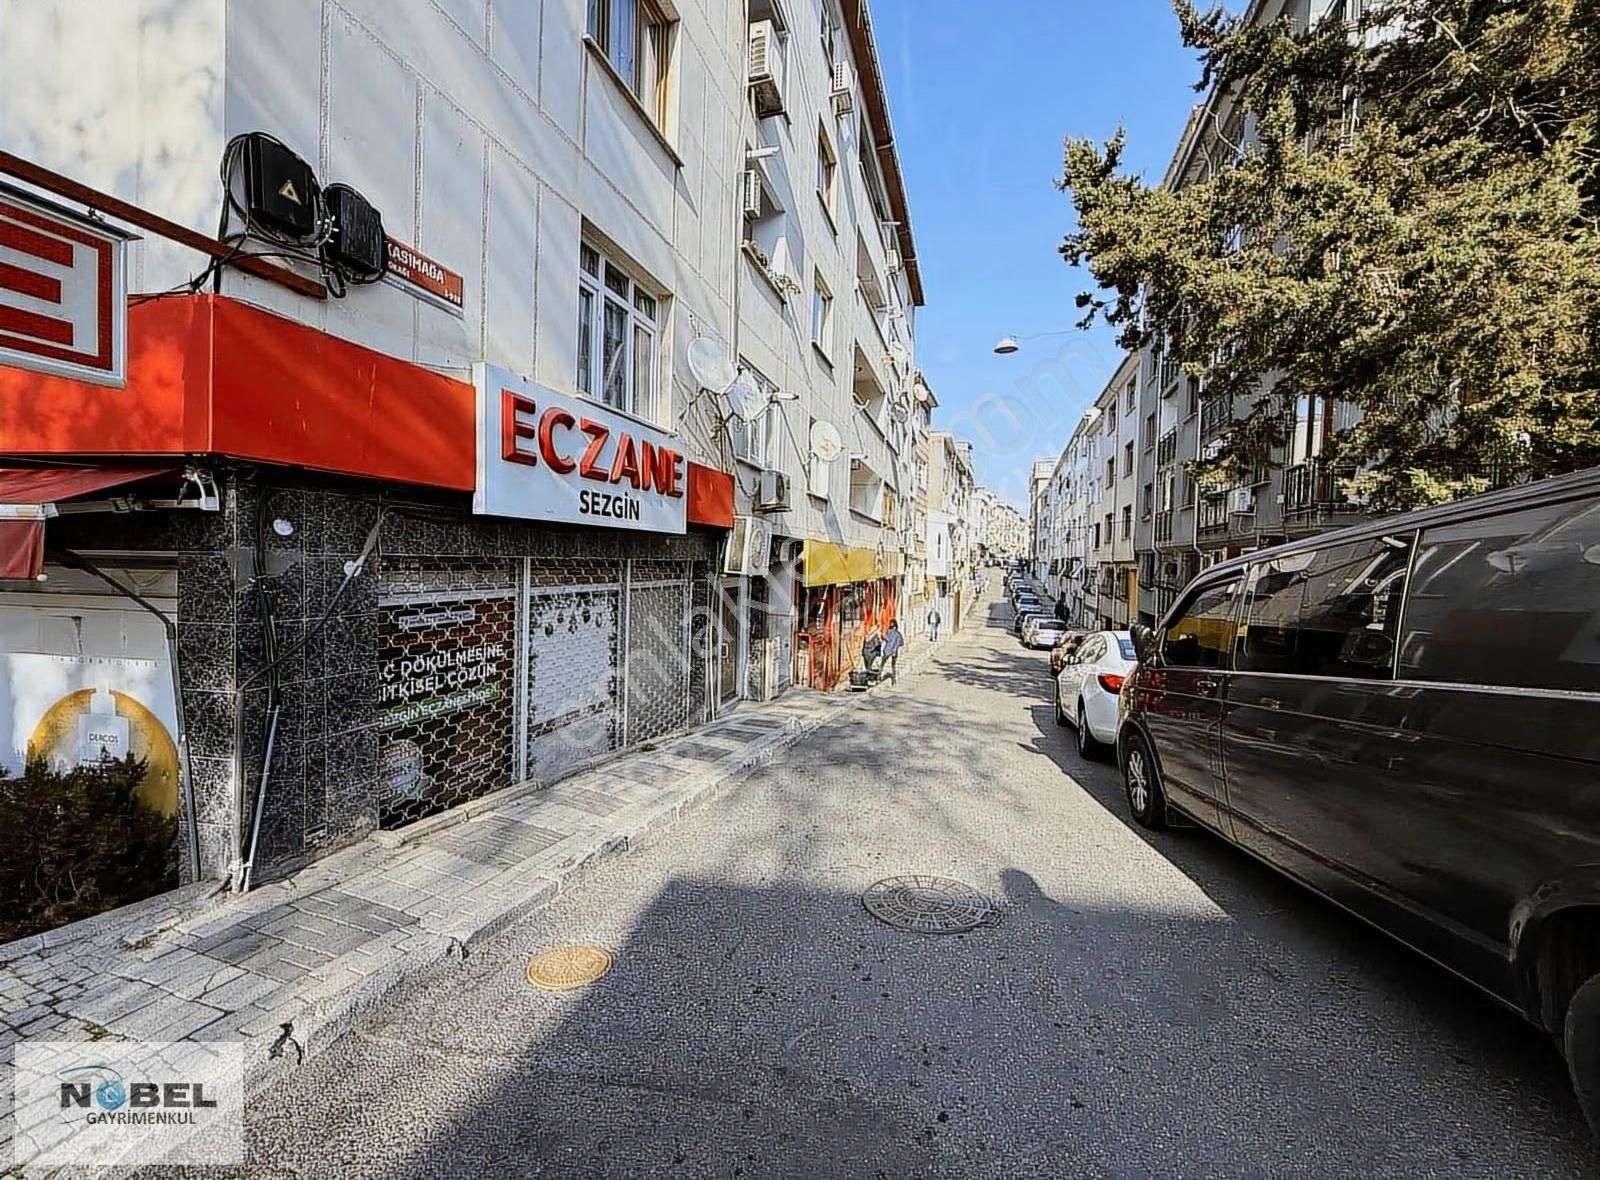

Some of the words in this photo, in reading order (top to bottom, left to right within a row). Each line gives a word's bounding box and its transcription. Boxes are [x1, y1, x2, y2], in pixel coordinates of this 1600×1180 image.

[501, 388, 684, 499] ECZANE
[579, 489, 640, 520] SEZGİN
[401, 644, 505, 676] DÖKÜLMESİNE
[447, 662, 496, 688] ÇÖZÜM
